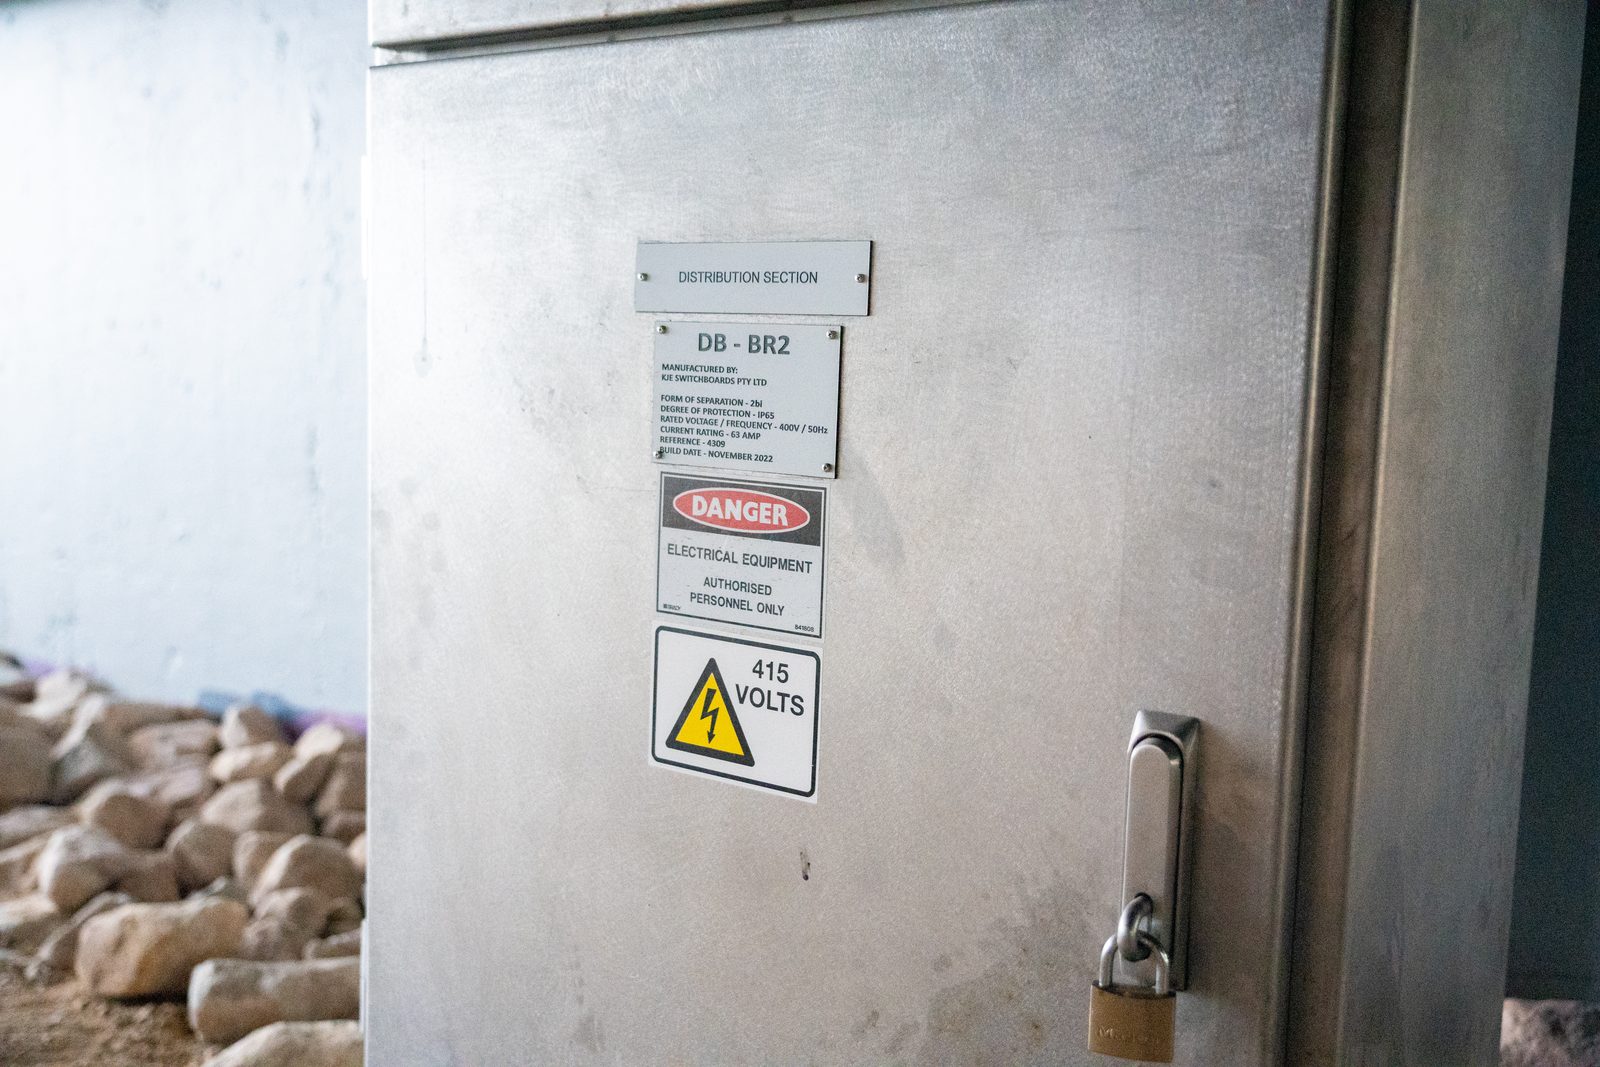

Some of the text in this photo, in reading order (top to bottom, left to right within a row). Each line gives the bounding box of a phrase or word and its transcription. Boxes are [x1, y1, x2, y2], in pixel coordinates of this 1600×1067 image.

[679, 271, 818, 283] DISTRIBUTION SECTION
[698, 333, 727, 352] DB
[748, 335, 790, 355] BR2
[662, 363, 725, 373] MANUFACTURED
[675, 375, 735, 384] SWITCHBOARDS
[697, 397, 744, 406] SEPARATION
[661, 406, 689, 414] DEGREE
[703, 408, 751, 417] PROTECTION
[660, 426, 694, 435] CURRENT
[696, 428, 724, 437] RATING
[685, 417, 718, 426] VOLTAGE
[726, 420, 772, 430] FREQUENCY
[779, 424, 800, 432] 400V
[808, 426, 828, 434] 50Hz
[660, 436, 700, 446] REFERENCE
[707, 439, 725, 447] 4309
[659, 447, 681, 455] BUILD
[683, 448, 701, 456] DATE
[708, 451, 752, 461] NOVEMBER
[692, 495, 788, 526] DANGER
[667, 543, 812, 573] ELECTRICAL EQUIPMENT
[703, 577, 772, 595] AUTHORISED
[690, 592, 753, 611] PERSONNEL
[757, 603, 784, 616] ONLY
[752, 659, 789, 683] 415
[735, 684, 805, 716] VOLTS
